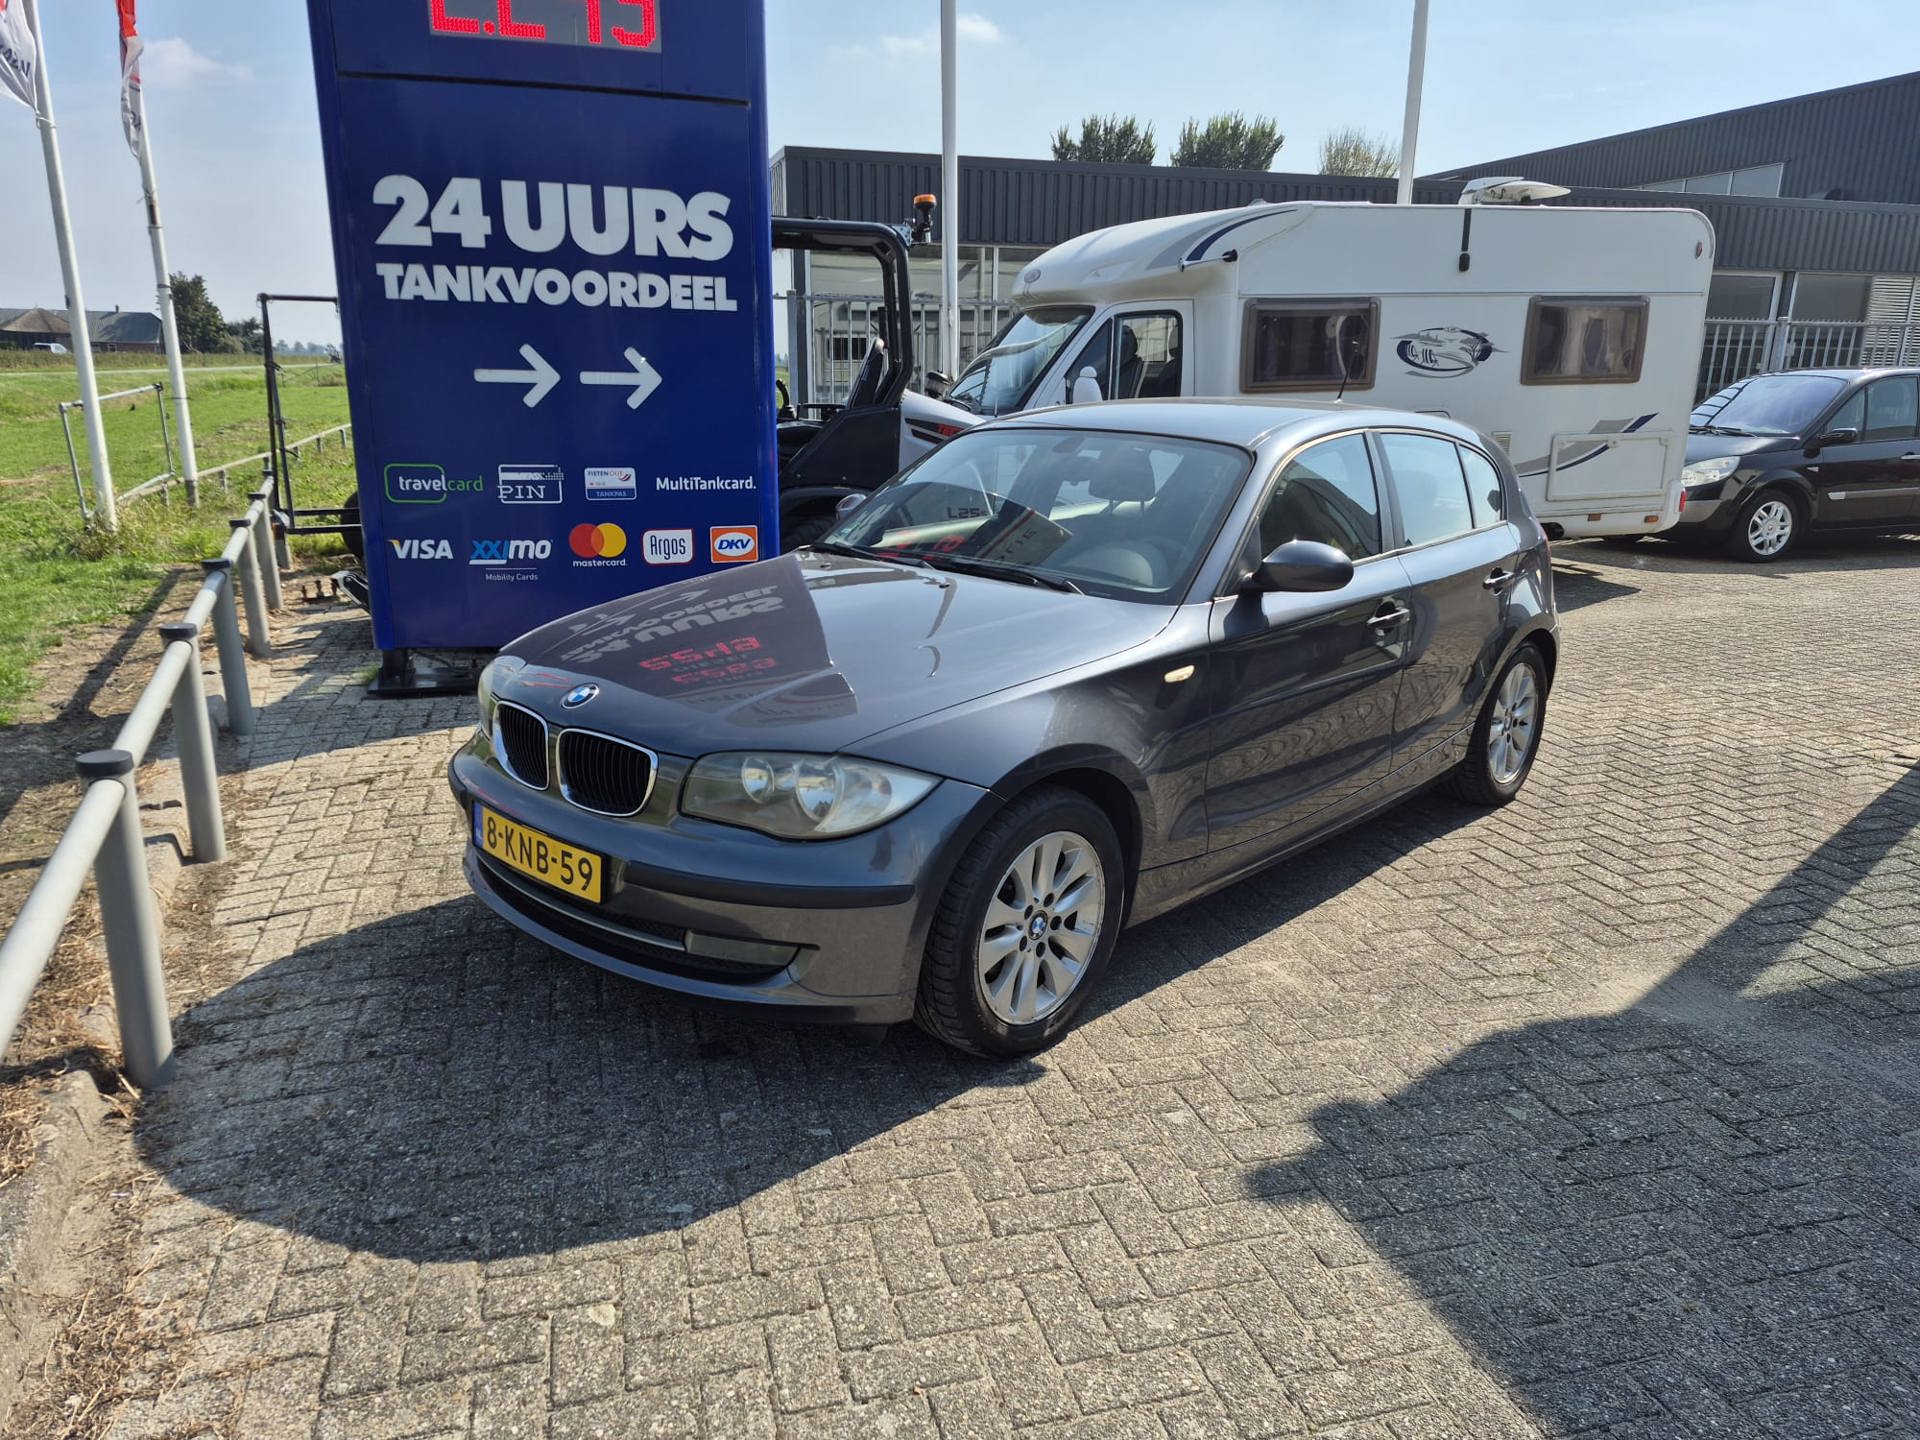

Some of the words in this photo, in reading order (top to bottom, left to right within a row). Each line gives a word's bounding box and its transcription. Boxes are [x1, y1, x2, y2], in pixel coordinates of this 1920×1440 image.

[373, 174, 492, 249] 24
[500, 179, 734, 261] UURS
[376, 263, 737, 311] TANKVOORDEEL
[399, 474, 484, 491] travelcard
[497, 485, 546, 499] PIN
[388, 540, 454, 560] VISA
[650, 535, 686, 560] Argos
[717, 538, 751, 550] DKV
[572, 558, 627, 568] mastercard
[485, 573, 515, 582] Mobility
[516, 573, 539, 581] Cards
[487, 816, 593, 891] 8-KNB-59
